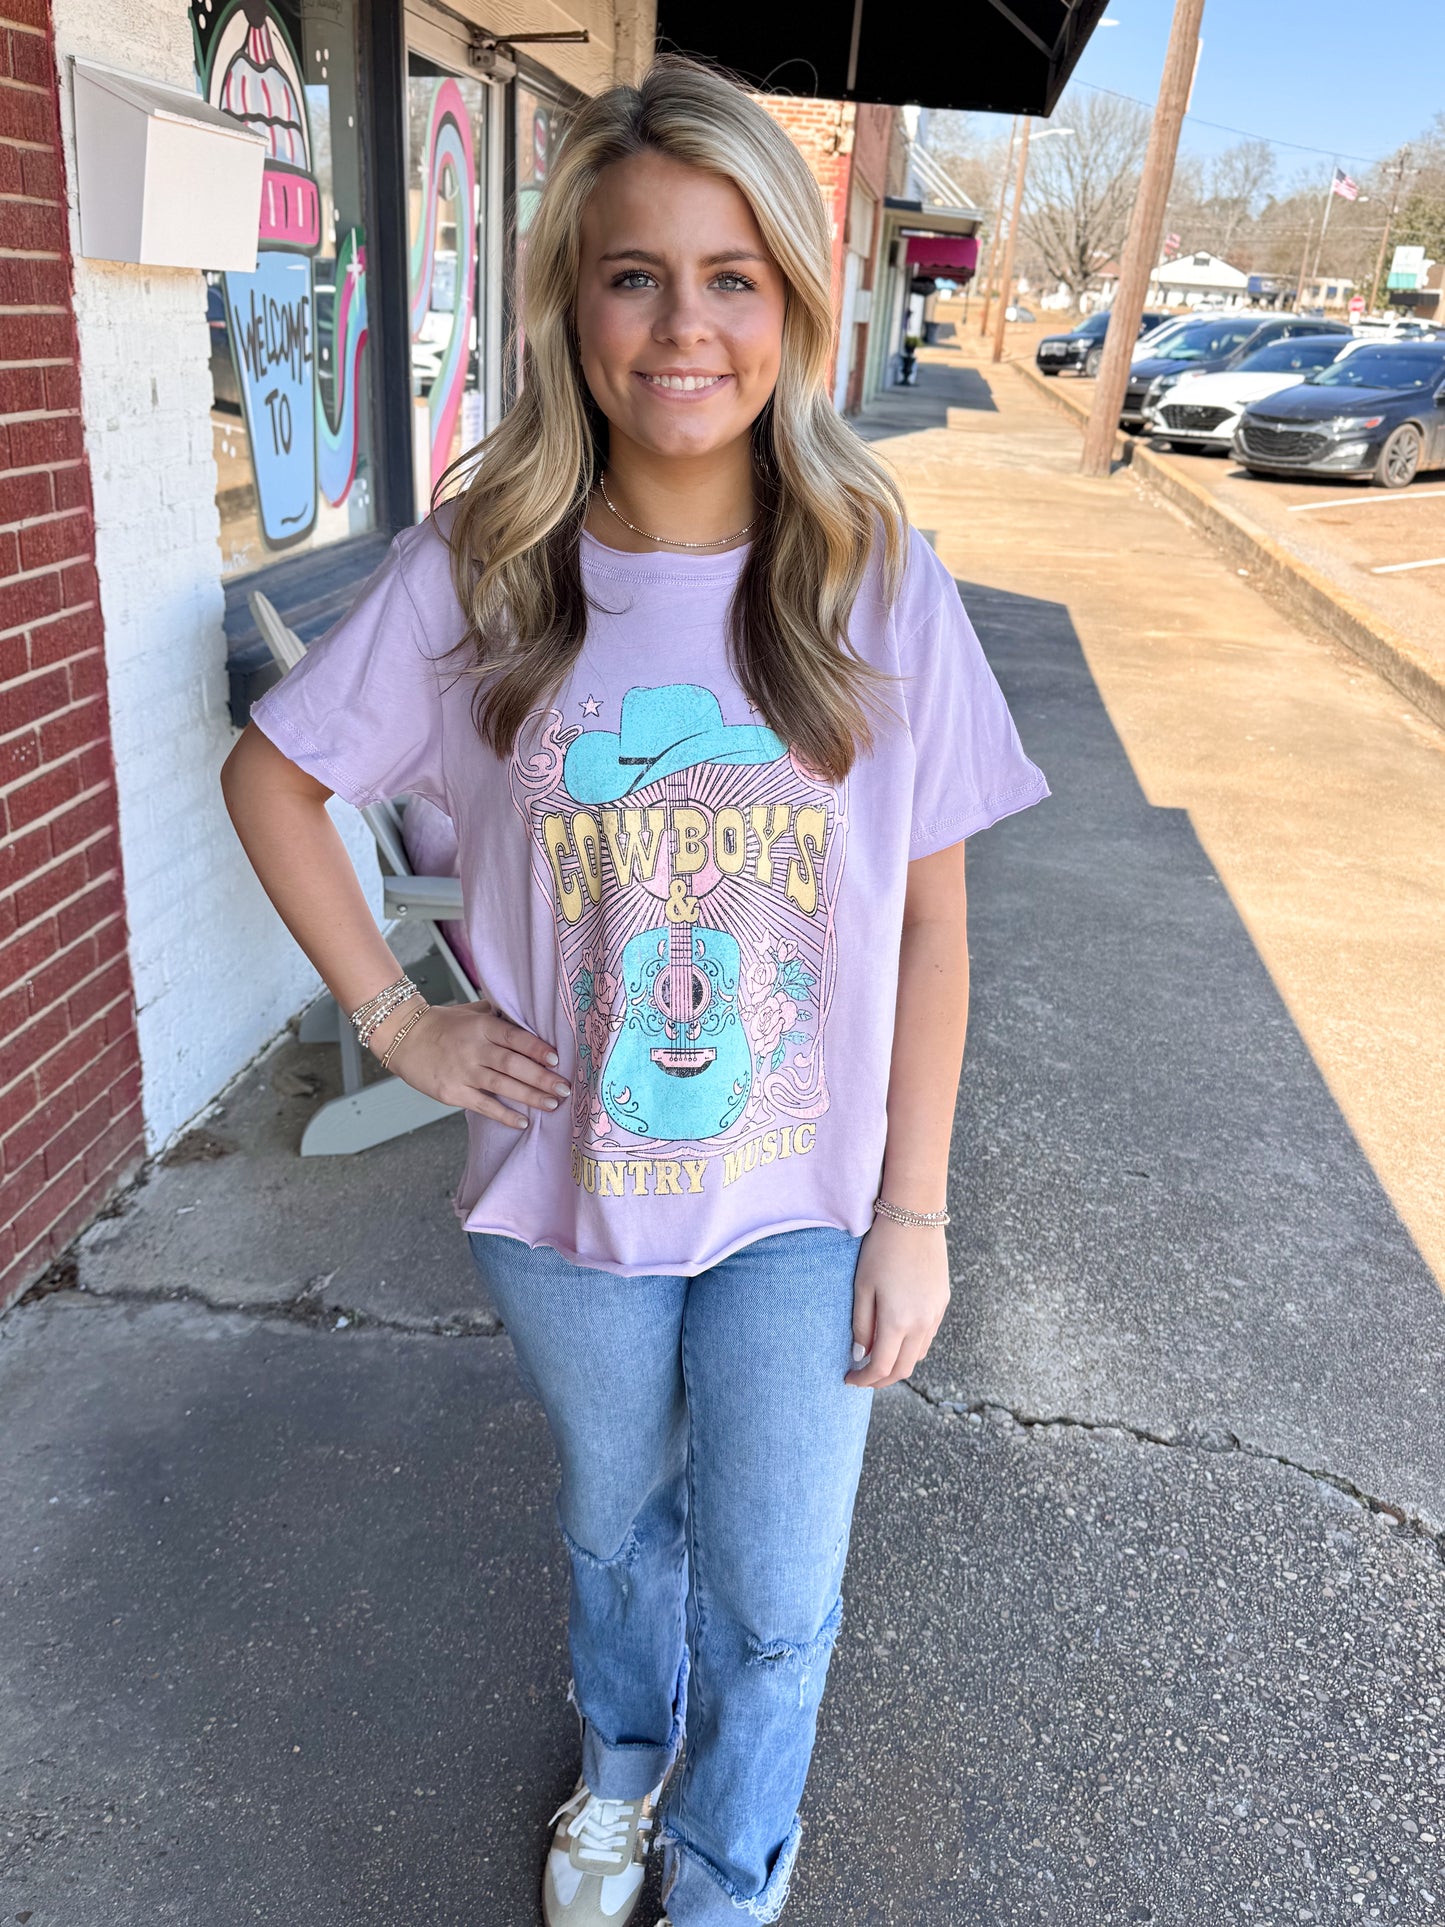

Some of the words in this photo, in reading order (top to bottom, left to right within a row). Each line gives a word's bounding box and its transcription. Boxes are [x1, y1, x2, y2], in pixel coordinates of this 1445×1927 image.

[234, 288, 313, 385] WELCOME
[264, 388, 293, 456] TO
[541, 804, 828, 925] COWBOYS
[665, 878, 700, 923] &
[722, 1123, 817, 1188] MUSIC
